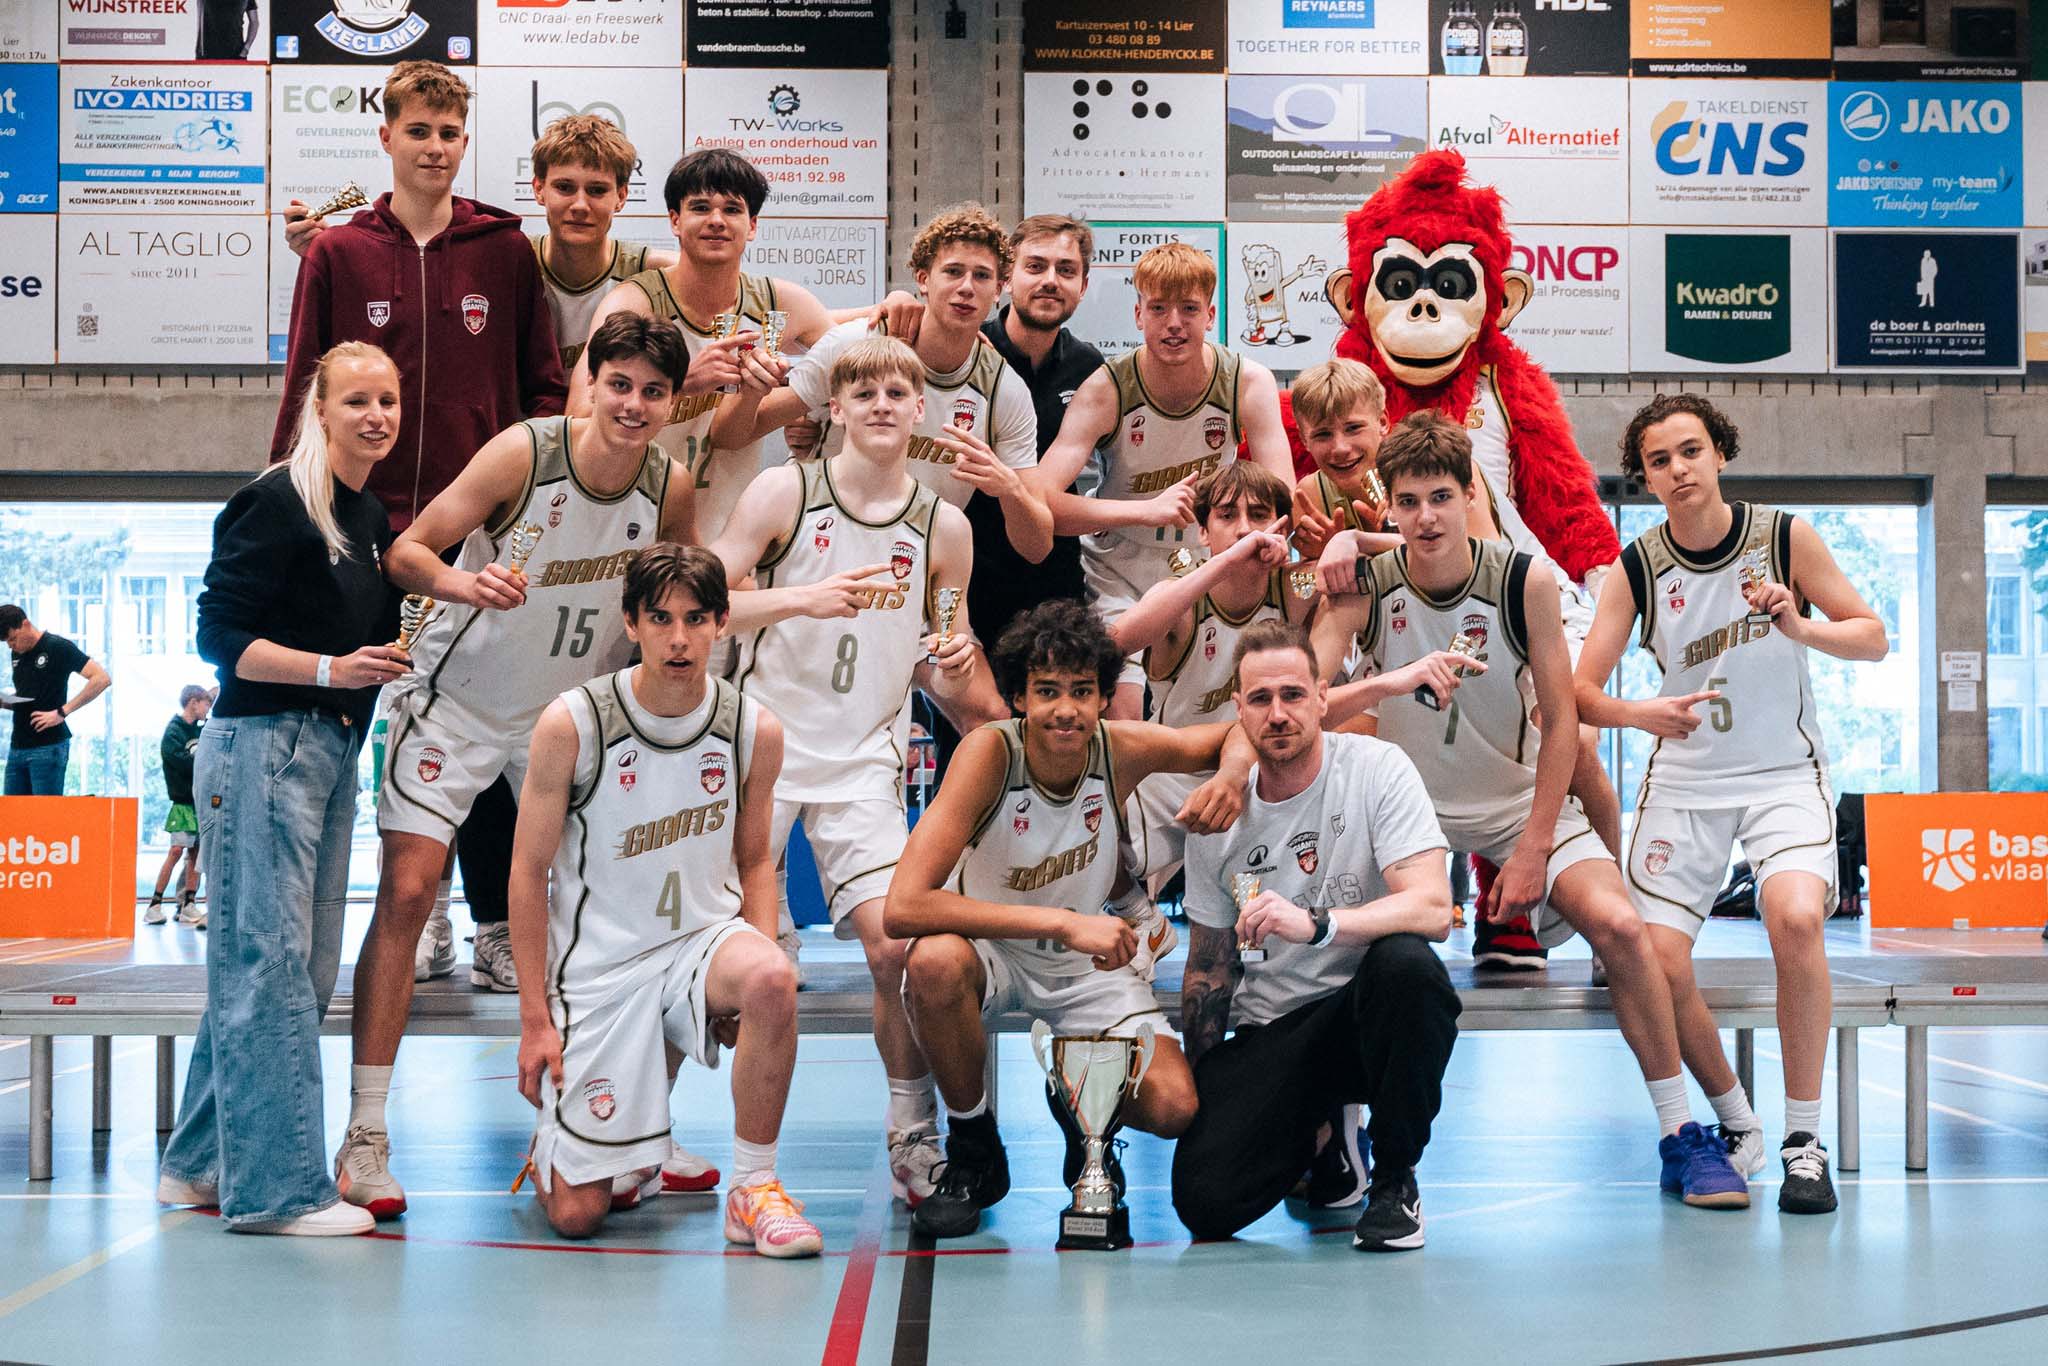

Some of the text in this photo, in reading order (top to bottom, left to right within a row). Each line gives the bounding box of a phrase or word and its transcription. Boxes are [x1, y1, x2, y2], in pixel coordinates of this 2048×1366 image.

[69, 0, 188, 14] WIJNSTREEK
[1292, 1, 1365, 12] REYNAERS
[499, 13, 664, 25] CNC Draai- en Freeswerk
[698, 8, 874, 19] beton & stabilisé bouwshop showroom
[1056, 21, 1129, 31] Kartuizersvest
[1134, 21, 1148, 31] 10
[1158, 21, 1171, 31] 14
[1175, 21, 1194, 31] Lier
[326, 18, 422, 51] RECLAME
[523, 31, 640, 44] www.ledabv.be
[1089, 35, 1161, 45] 03 480 08 89
[3, 37, 19, 46] Lier
[697, 43, 805, 52] vandenbraembussche.be
[1236, 40, 1420, 54] TOGETHER FOR BETTER
[12, 51, 46, 60] tot 17u
[1035, 49, 1214, 60] WWW.KLOKKEN-HENDERYCKX.BE
[1649, 64, 1747, 72] www.adrtechnics.be
[1921, 67, 2017, 76] www.adrtechnics.be
[111, 75, 212, 89] Zakenkantoor
[77, 91, 245, 110] IVO ANDRIES
[1698, 100, 1808, 114] TAKELDIENST
[1900, 99, 2011, 134] JAKO
[729, 118, 843, 132] TW-Works
[96, 134, 162, 142] VERZEKERINGEN
[1438, 126, 1620, 146] Afval Alternatief
[74, 142, 93, 150] ALLE
[695, 136, 877, 150] Aanleg en onderhoud van
[1656, 120, 1808, 176] CNS
[299, 149, 379, 159] SIERPLEISTER
[1052, 148, 1204, 158] Advocatenkantoor
[1242, 150, 1289, 159] OUTDOOR
[1291, 151, 1349, 159] LANDSCAPE
[85, 169, 145, 178] VERZEKEREN
[152, 169, 162, 178] IS
[168, 169, 192, 178] MIJN
[1042, 167, 1210, 178] Pittoors Hermans
[1273, 164, 1320, 173] tuinaanleg
[1336, 164, 1385, 173] onderhoud
[764, 172, 845, 183] 3/481.92.98
[1932, 175, 1998, 193] my-team
[83, 187, 241, 196] WWW.ANDRIESVERZEKERINGEN.BE
[17, 194, 48, 204] acer
[69, 198, 138, 206] KONINGSPLEIN
[178, 199, 255, 207] KONINGSHOOIKT
[1873, 193, 1979, 219] Thinking together
[762, 227, 866, 242] UITVAARTZORG
[1120, 234, 1179, 245] FORTIS
[79, 231, 251, 257] AL TAGLIO
[757, 248, 866, 265] DEN BOGAERT
[1090, 249, 1124, 262] NP
[130, 267, 198, 279] since 2011
[814, 269, 866, 286] JORAS
[1551, 286, 1620, 300] Processing
[1684, 310, 1772, 320] RAMEN & DEUREN
[161, 324, 252, 333] RISTORANTE PIZZERIA
[1522, 327, 1550, 335] waste
[1552, 328, 1577, 337] your
[1580, 326, 1614, 336] waste!
[1870, 320, 1986, 333] de boer & partners
[151, 337, 179, 345] GROTE
[181, 337, 207, 345] MARKT
[216, 337, 235, 345] 2500
[1949, 337, 1986, 346] groep
[687, 435, 713, 488] 12
[550, 605, 599, 658] 15
[832, 634, 859, 694] 8
[1708, 678, 1733, 733] 5
[621, 799, 728, 857] GIANTS
[1989, 829, 2048, 858] bas
[1982, 859, 2048, 881] .vlaa
[656, 871, 682, 930] 4
